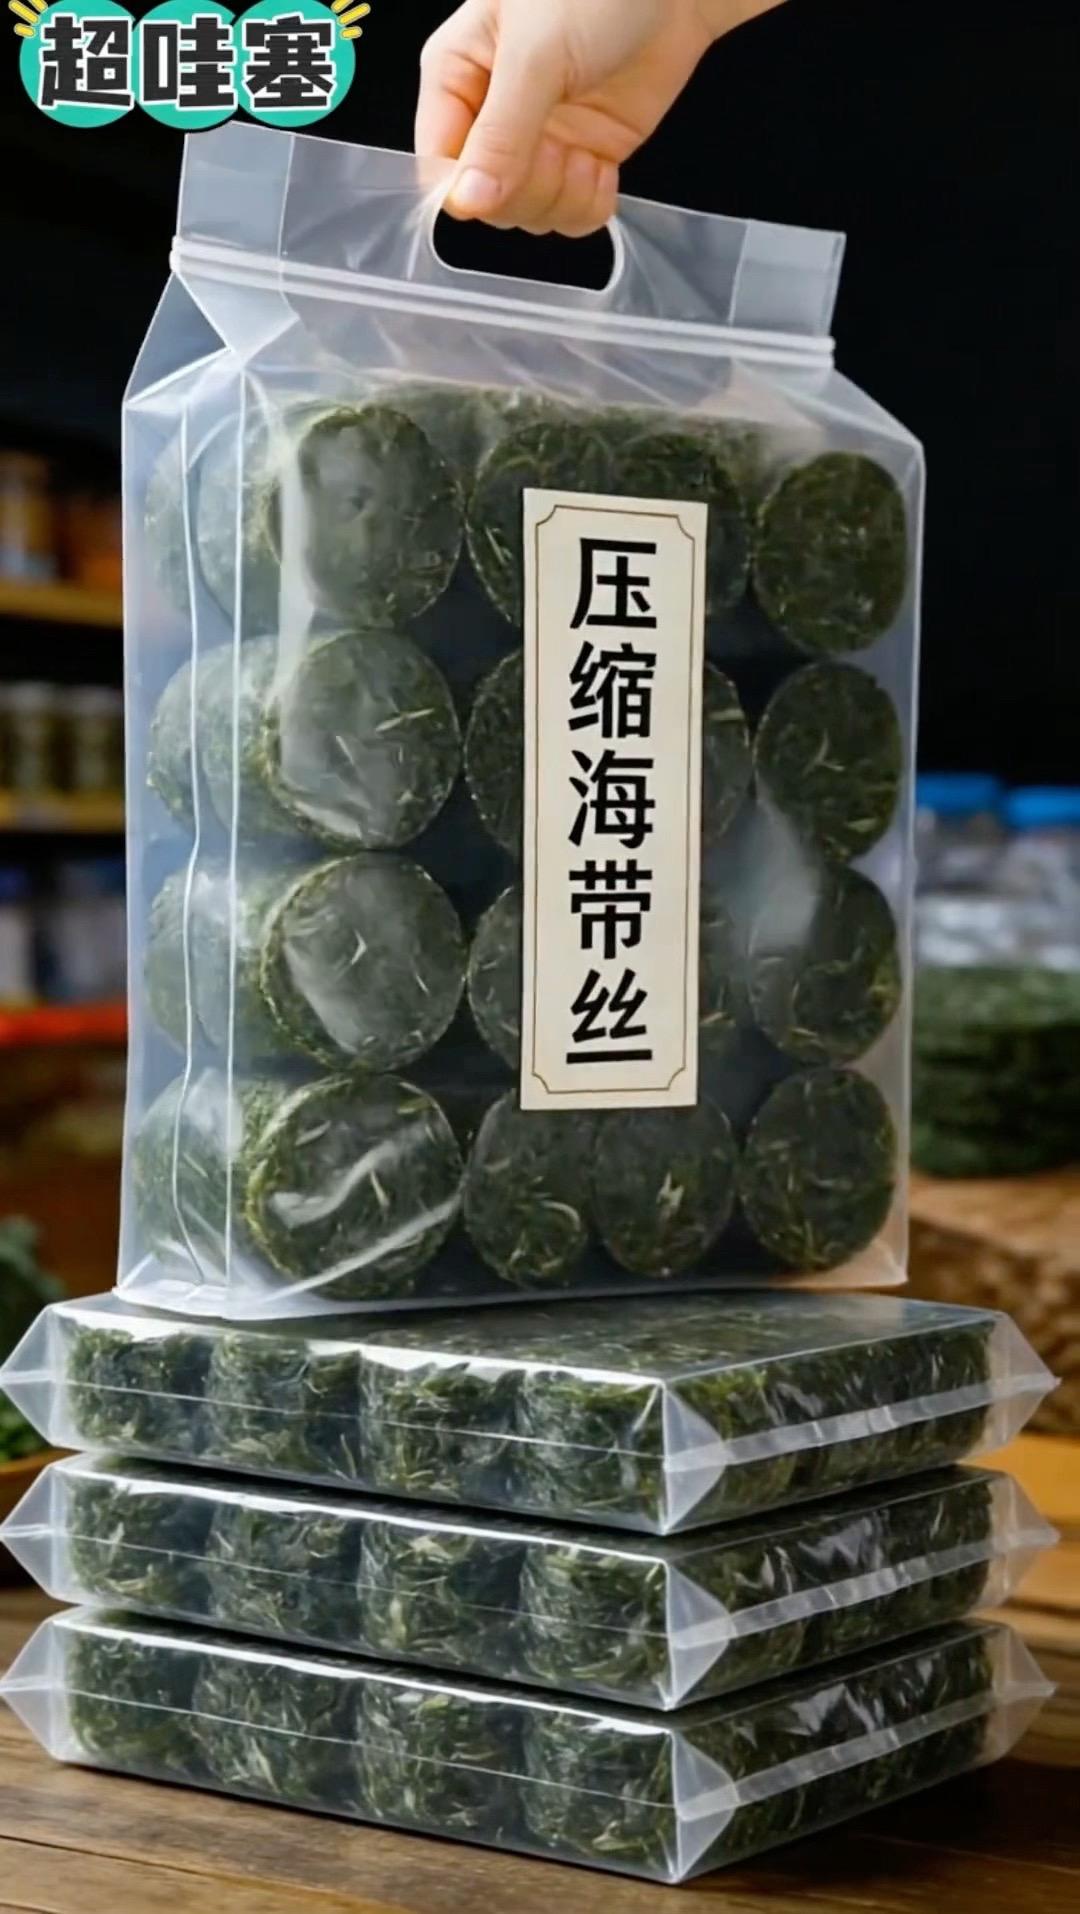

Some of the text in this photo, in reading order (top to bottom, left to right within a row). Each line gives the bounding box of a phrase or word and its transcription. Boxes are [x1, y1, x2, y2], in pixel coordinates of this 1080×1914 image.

[566, 537, 657, 1064] 压缩海带丝
